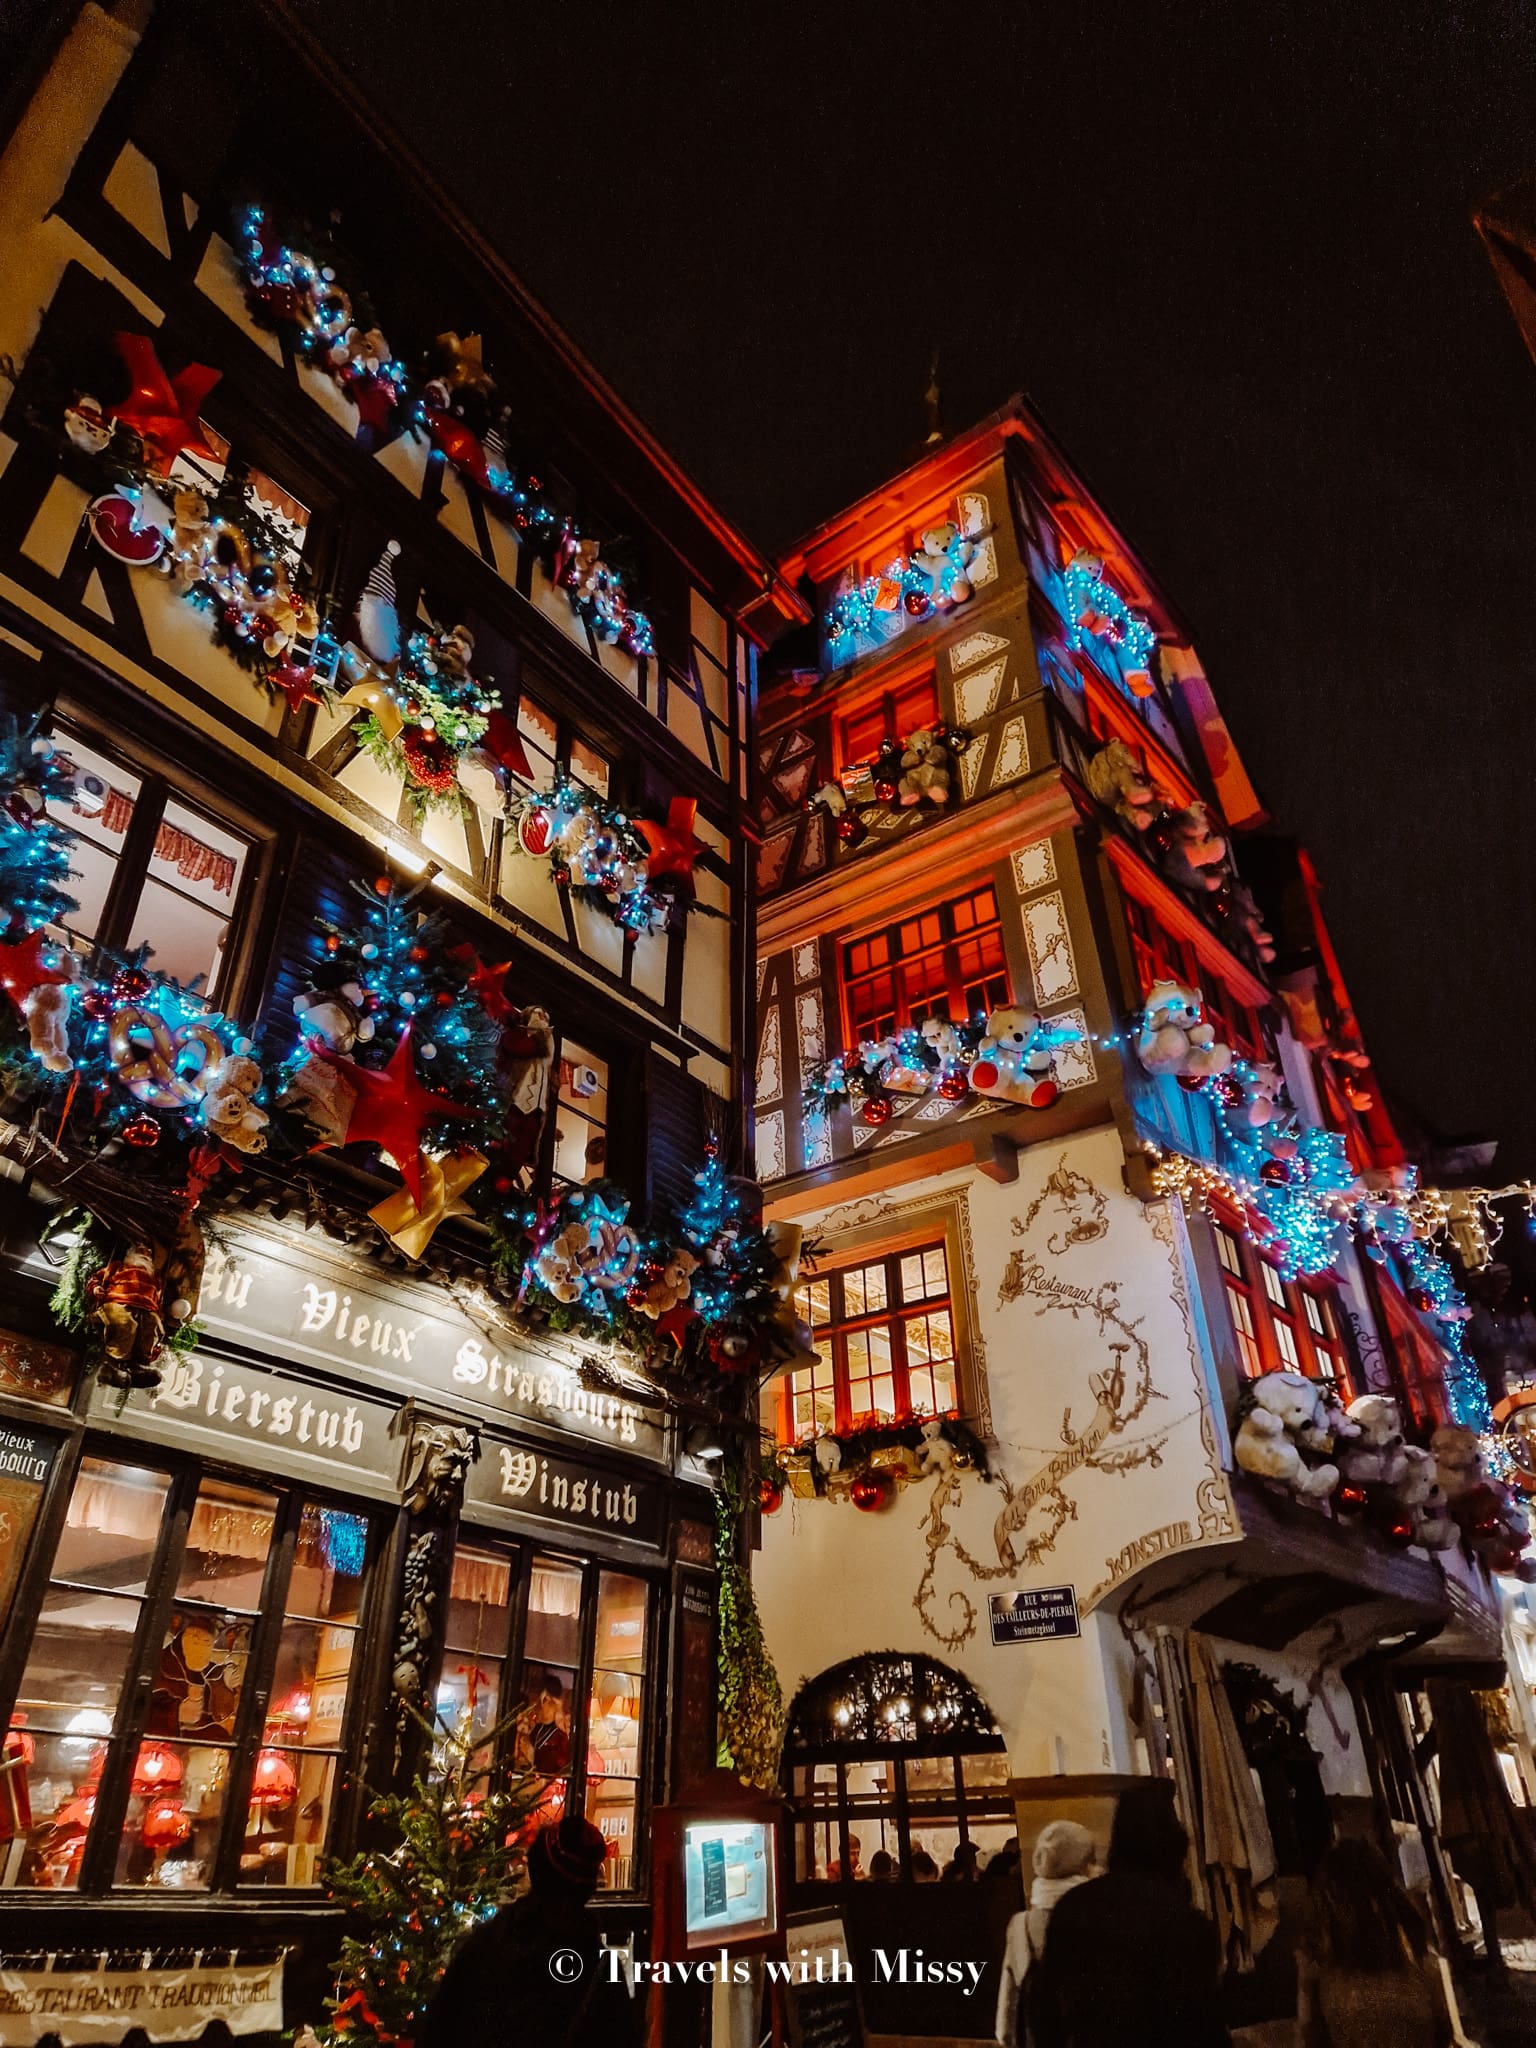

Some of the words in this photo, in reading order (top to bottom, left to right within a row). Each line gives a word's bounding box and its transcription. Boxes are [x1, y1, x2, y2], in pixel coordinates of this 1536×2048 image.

[1022, 1264, 1094, 1303] Restaurant
[301, 1282, 416, 1363] Vieux
[452, 1338, 638, 1443] Strasbourg
[151, 1355, 364, 1454] Bierstub
[499, 1446, 638, 1525] Winstub
[1105, 1520, 1193, 1581] WINSTUB
[993, 1612, 1006, 1625] DES
[1024, 1594, 1038, 1606] RUE
